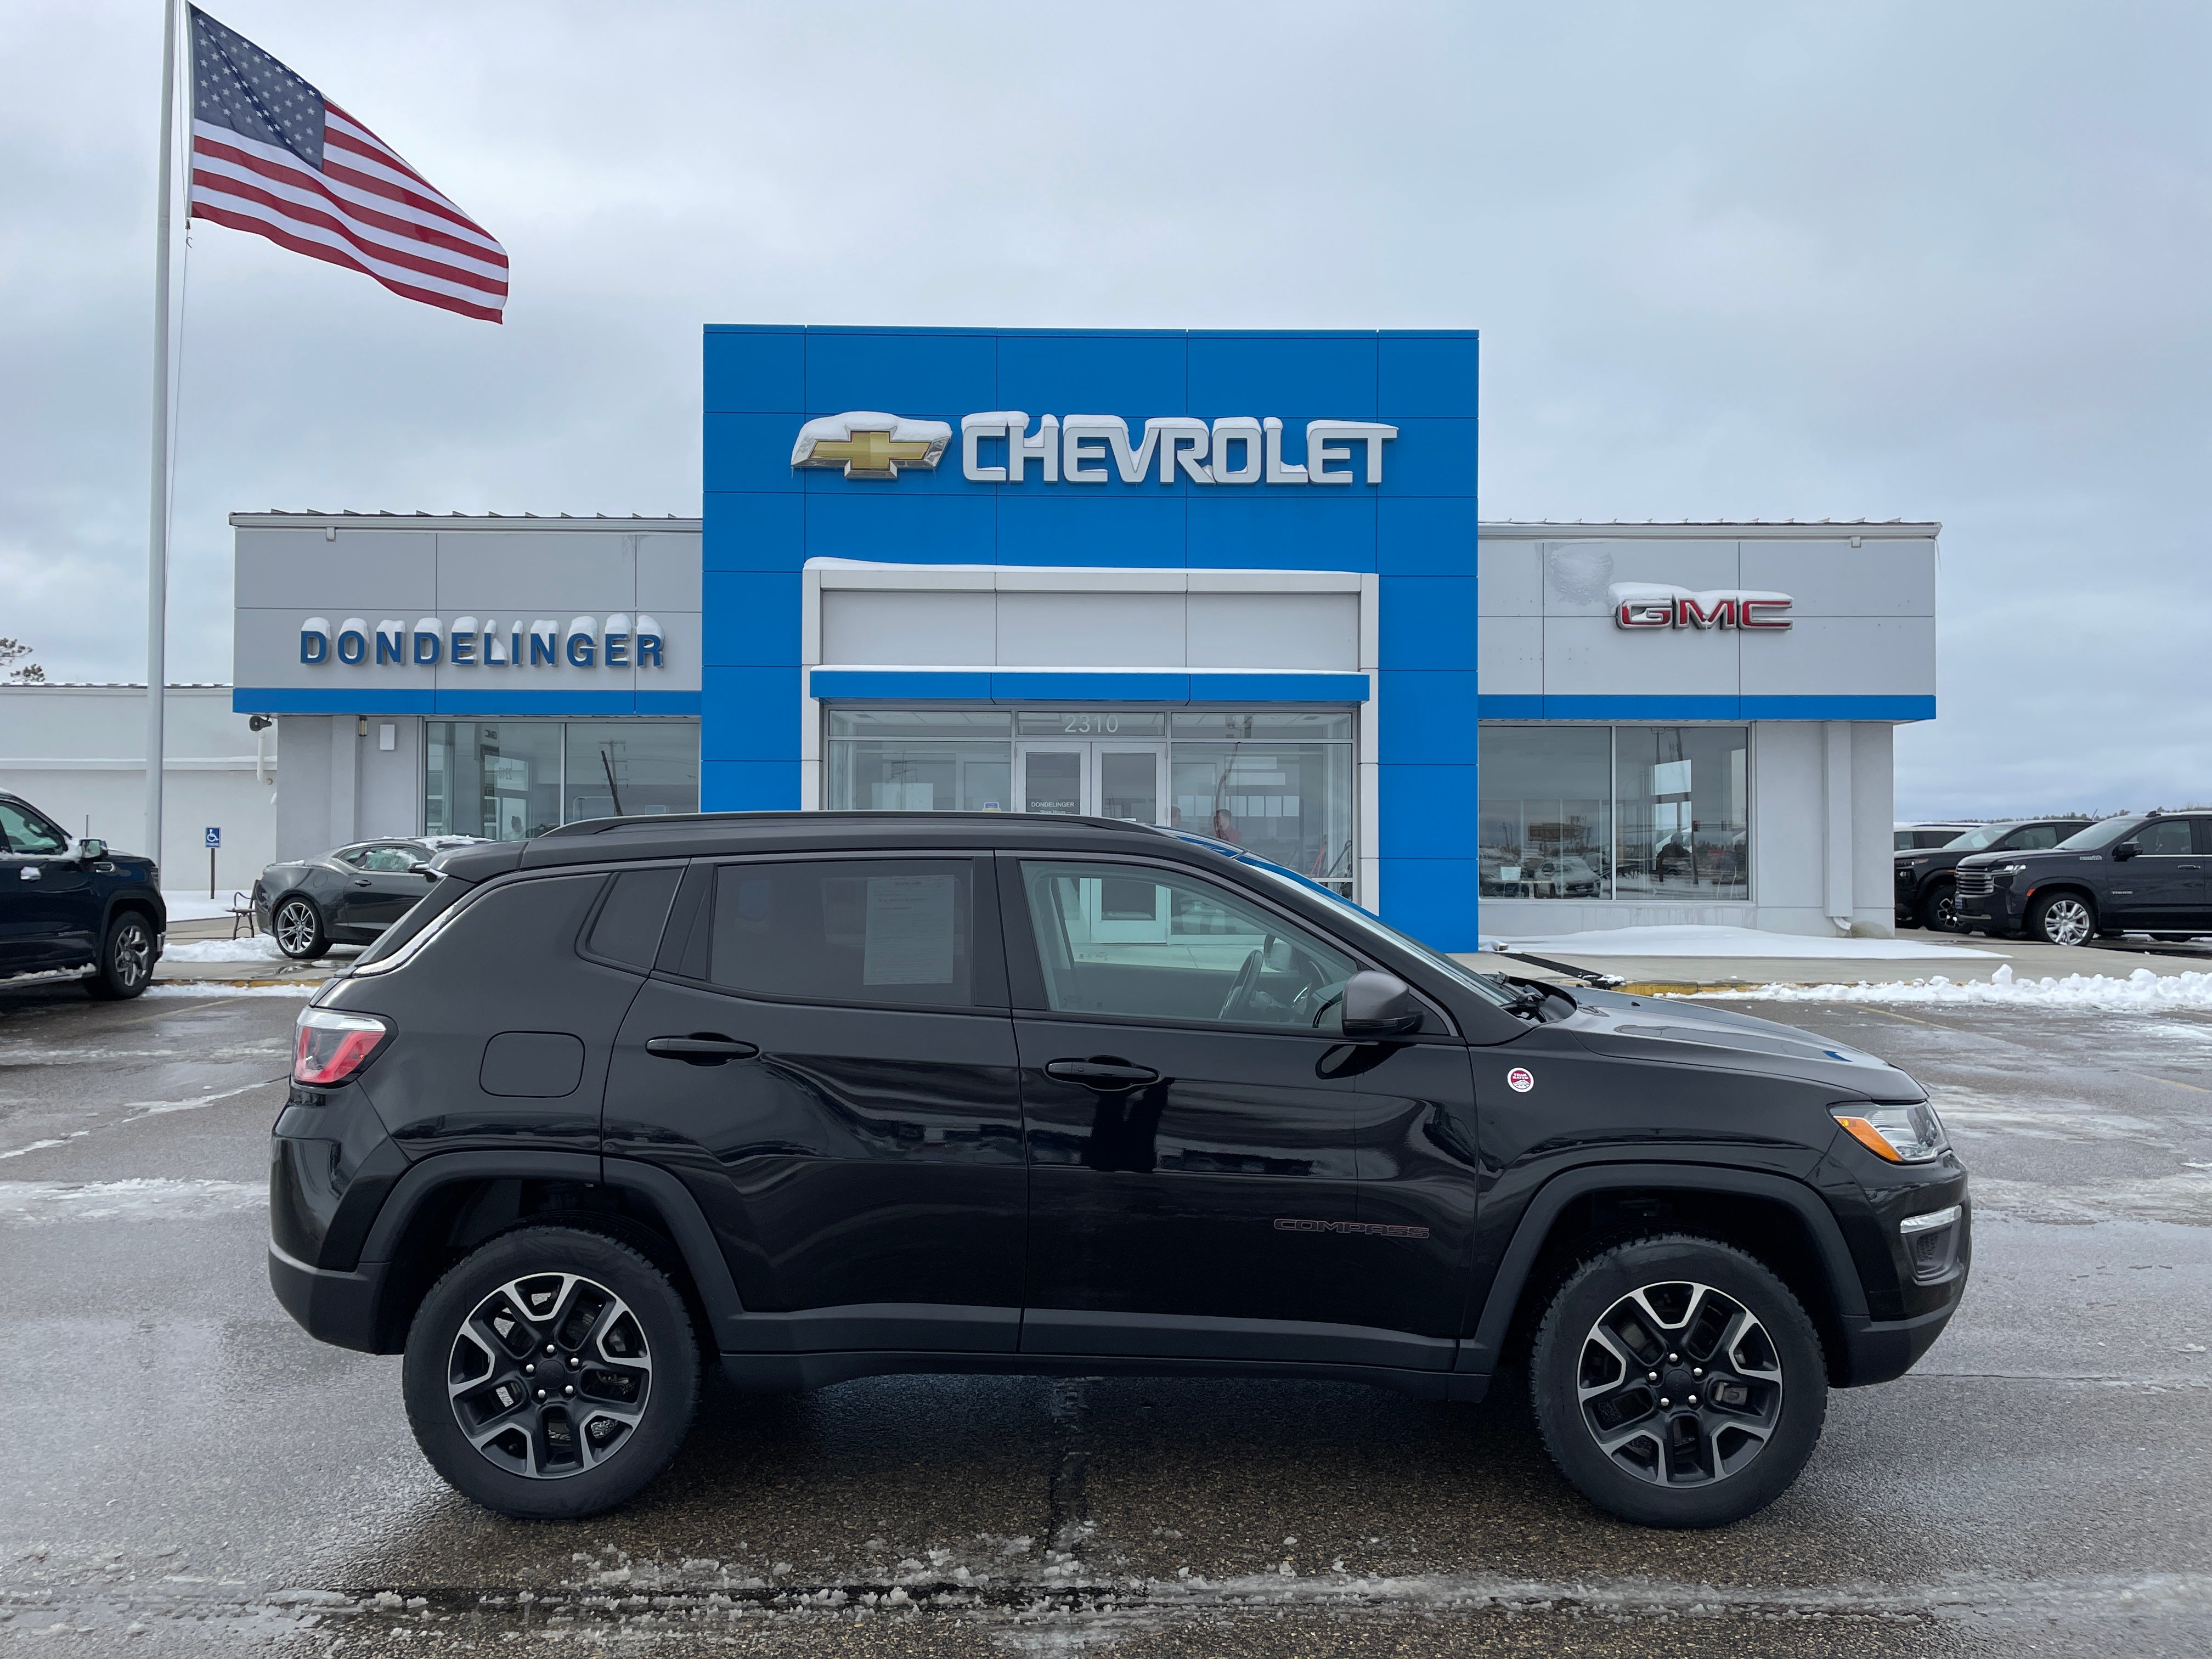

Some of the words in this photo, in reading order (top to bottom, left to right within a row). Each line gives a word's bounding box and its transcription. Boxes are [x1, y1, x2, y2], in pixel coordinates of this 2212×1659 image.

[961, 421, 1399, 485] CHEVROLET
[1616, 596, 1793, 630] GMC
[300, 629, 664, 668] DONDELINGER
[1064, 715, 1119, 733] 2310
[1274, 1218, 1430, 1239] COMPASS
